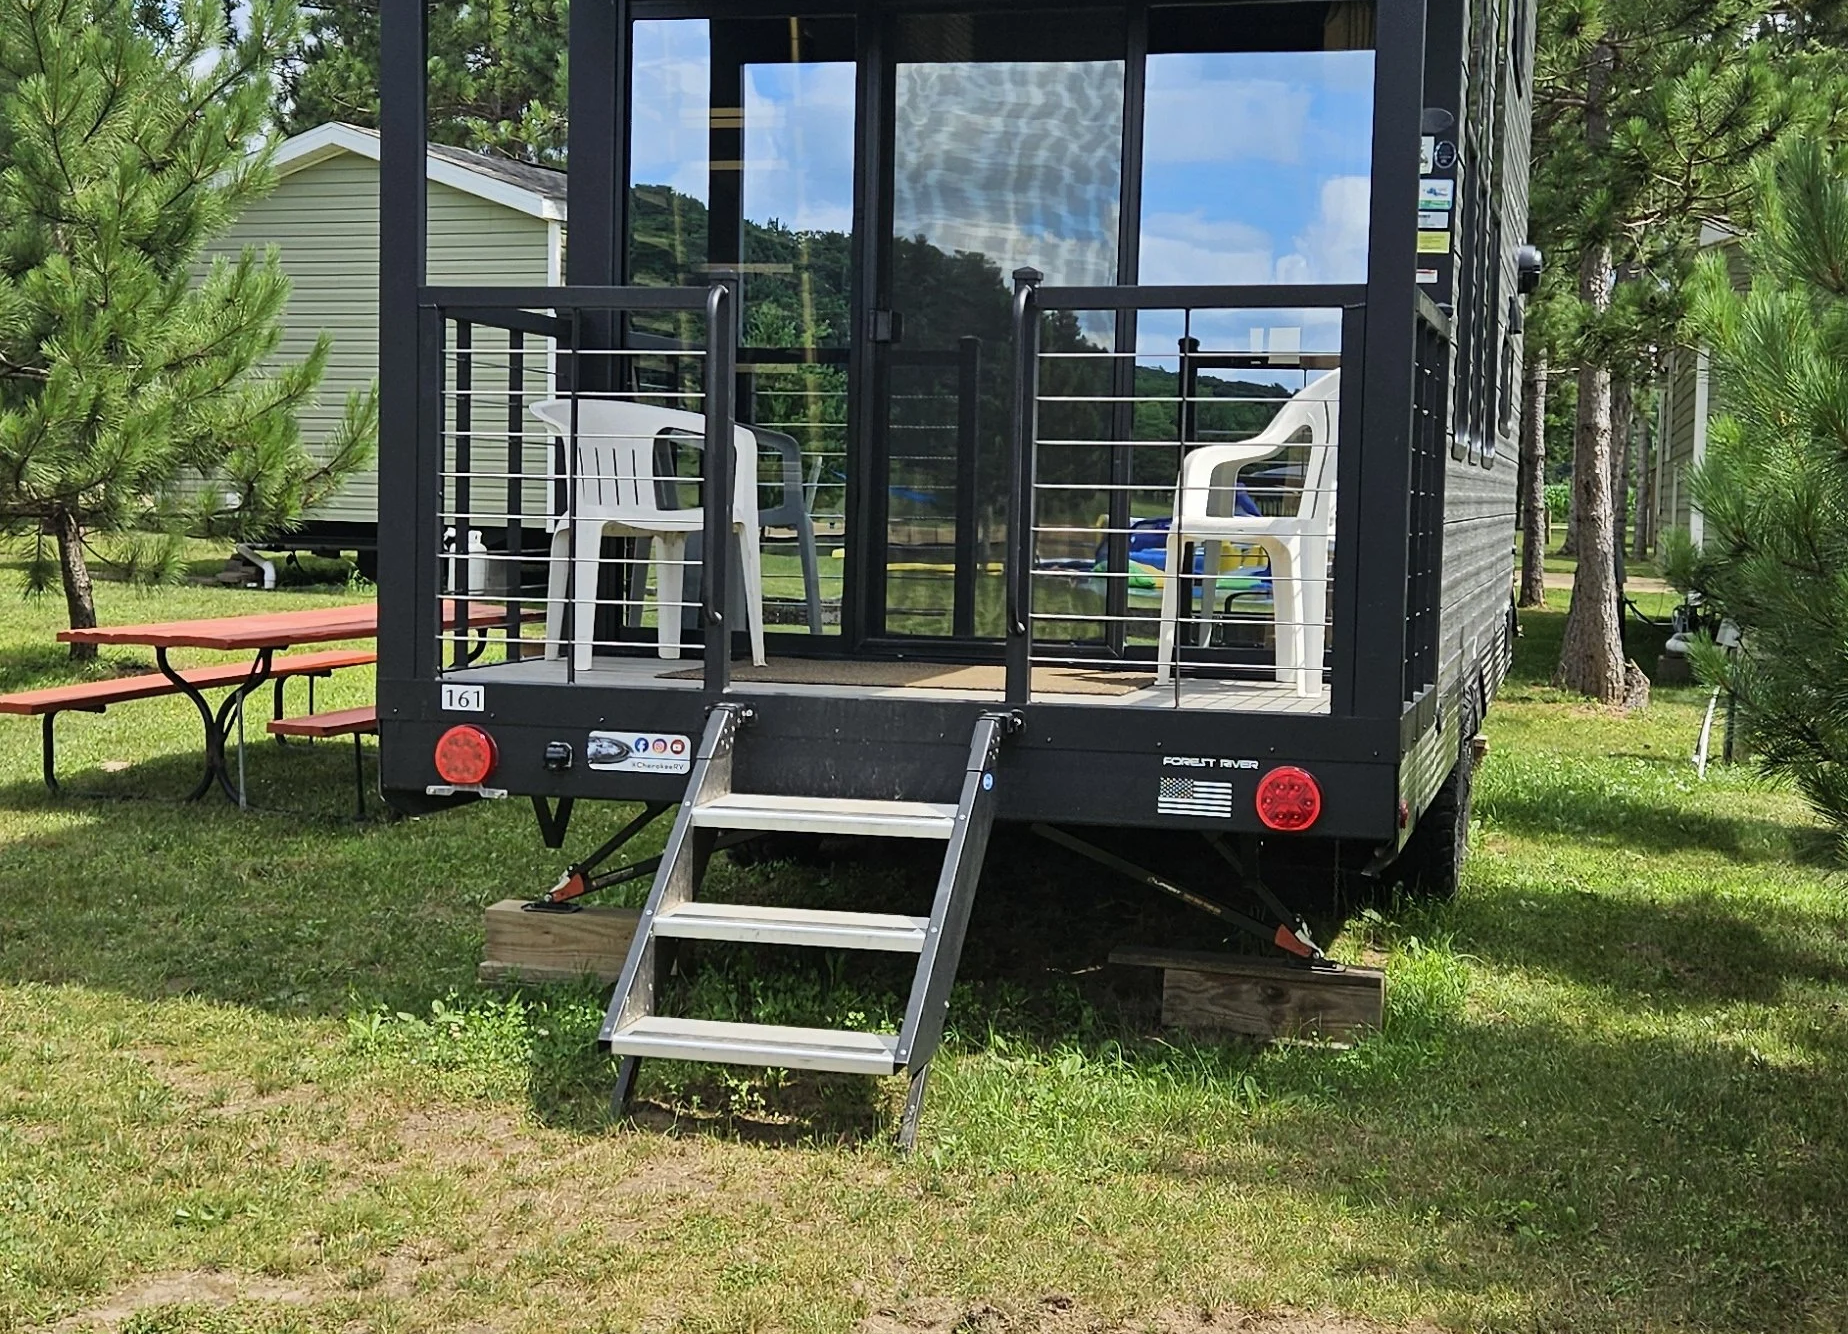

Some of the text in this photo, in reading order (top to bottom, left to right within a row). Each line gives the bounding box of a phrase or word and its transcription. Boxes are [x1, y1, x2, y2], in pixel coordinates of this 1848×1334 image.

[446, 689, 480, 708] 161
[1163, 756, 1259, 770] FOREST RIVER
